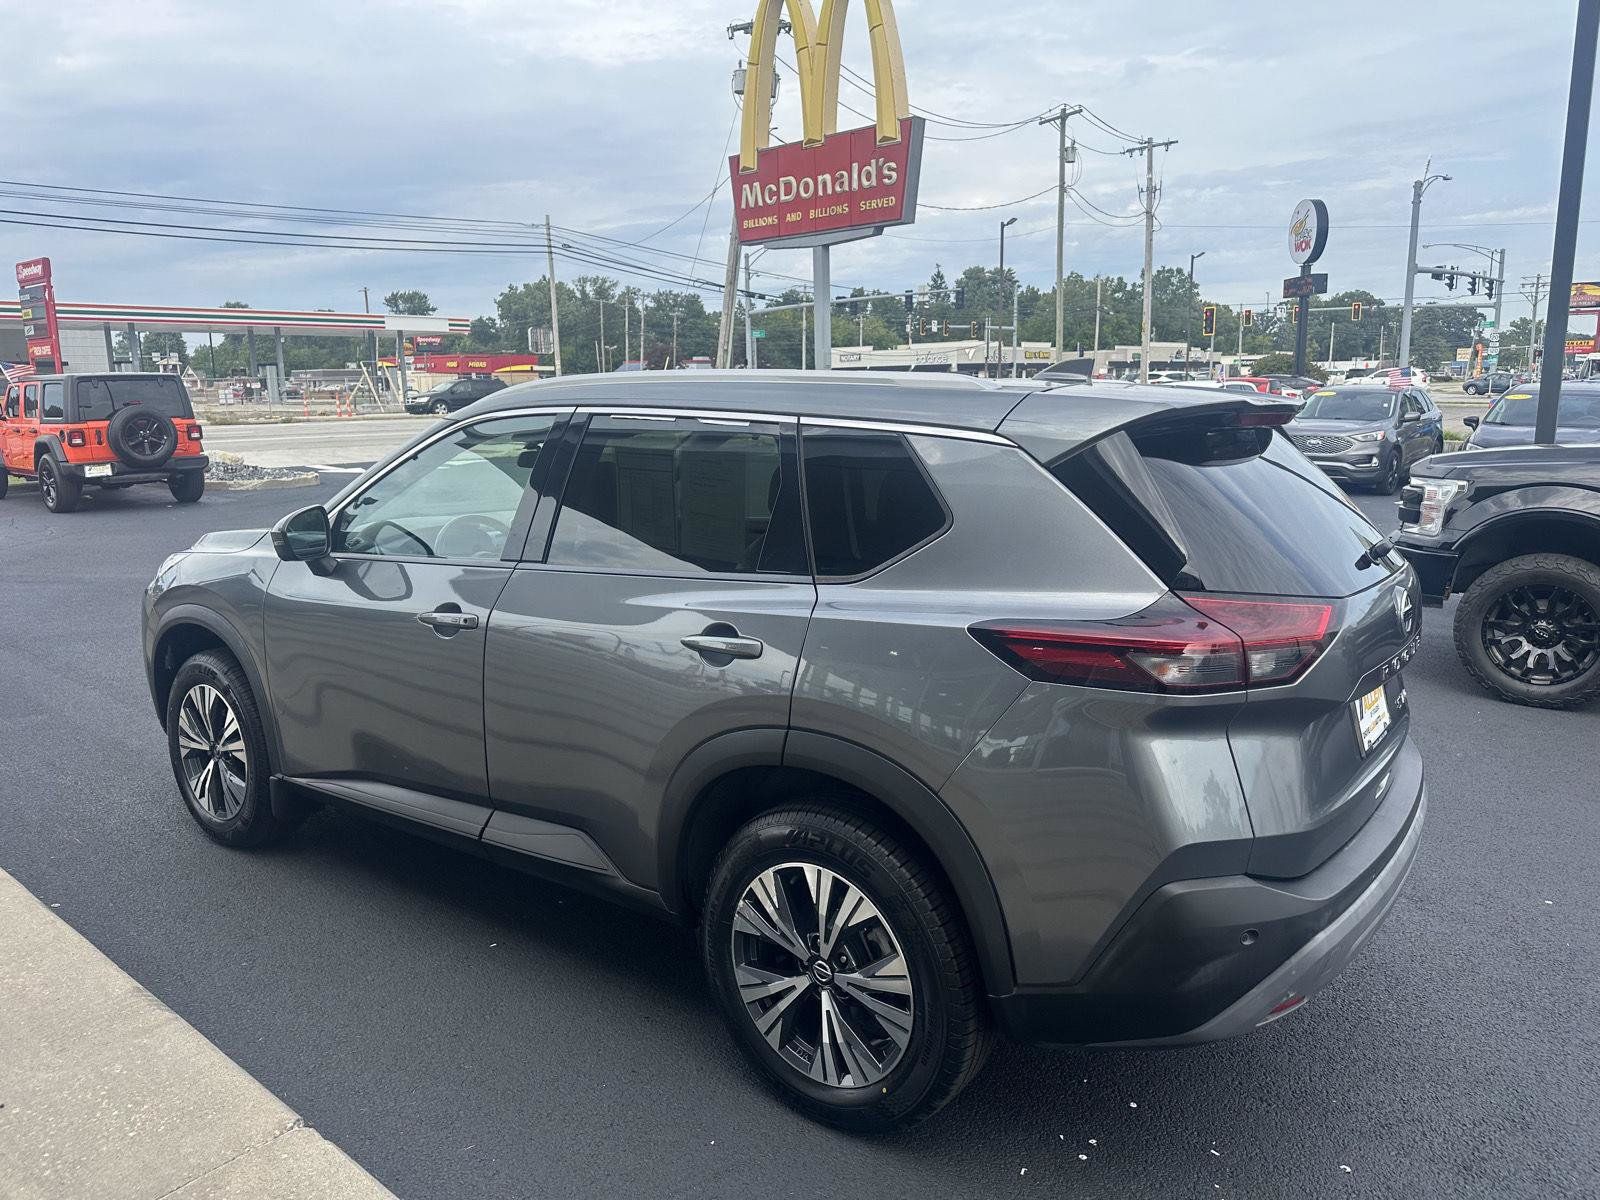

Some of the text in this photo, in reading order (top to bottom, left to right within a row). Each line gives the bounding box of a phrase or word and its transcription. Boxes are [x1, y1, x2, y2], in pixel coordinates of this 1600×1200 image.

[741, 158, 898, 209] McDonald's
[743, 196, 896, 229] BILLIONS AND BILLIONS SERVED
[1295, 239, 1312, 252] WOK
